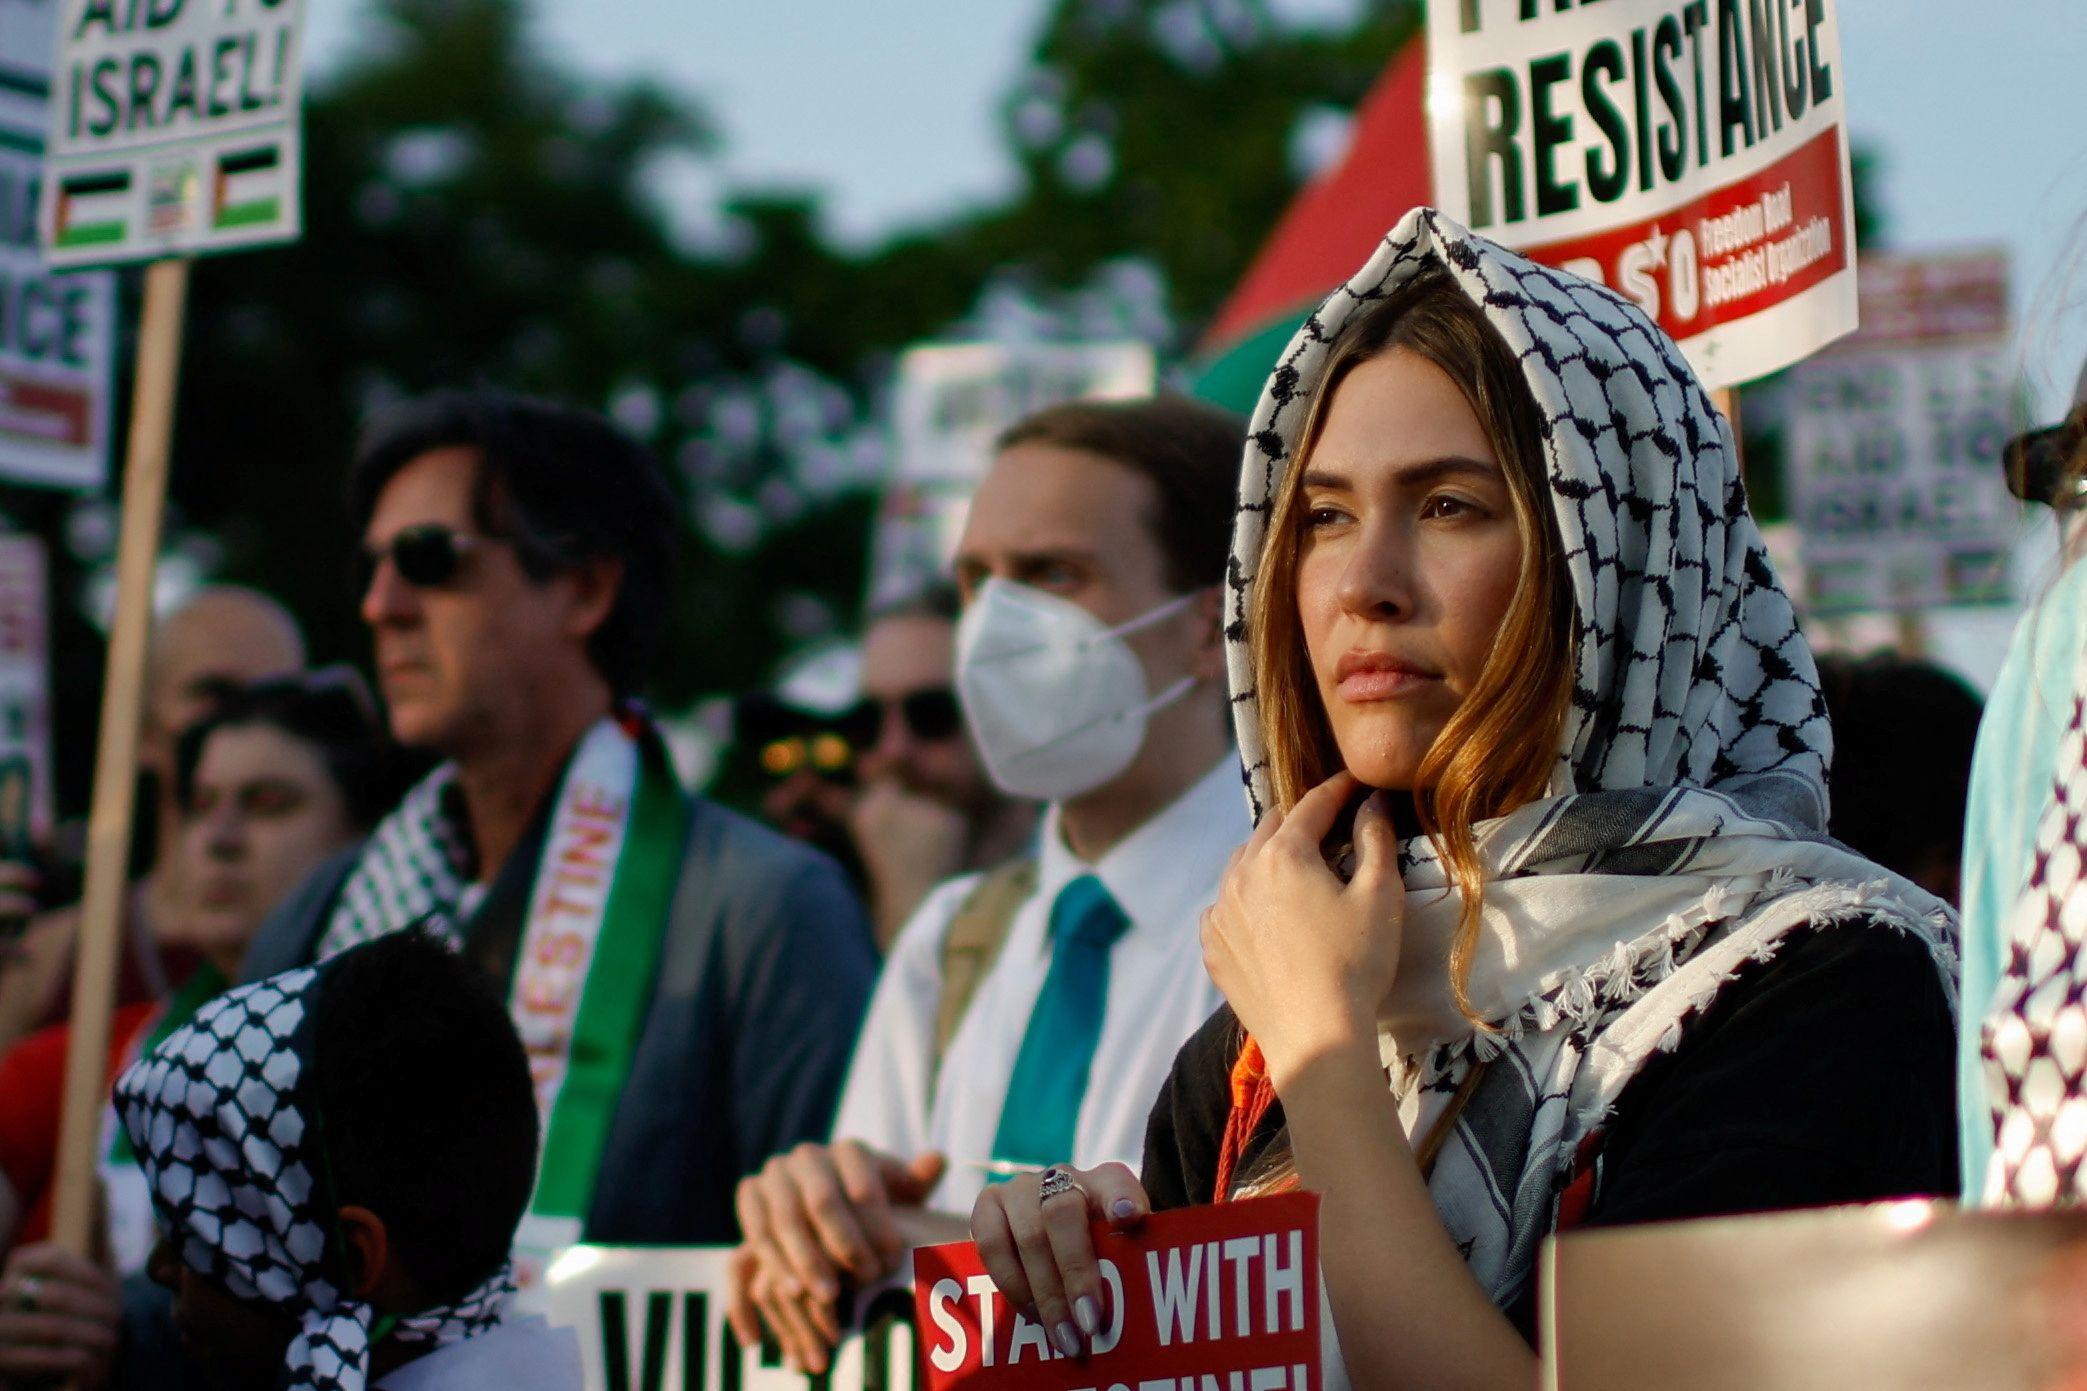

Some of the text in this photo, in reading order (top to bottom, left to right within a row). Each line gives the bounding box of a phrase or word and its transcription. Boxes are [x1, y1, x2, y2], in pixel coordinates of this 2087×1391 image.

[67, 28, 290, 141] ISRAEL!
[1462, 0, 1833, 229] RESISTANCE
[1146, 1229, 1304, 1346] WITH
